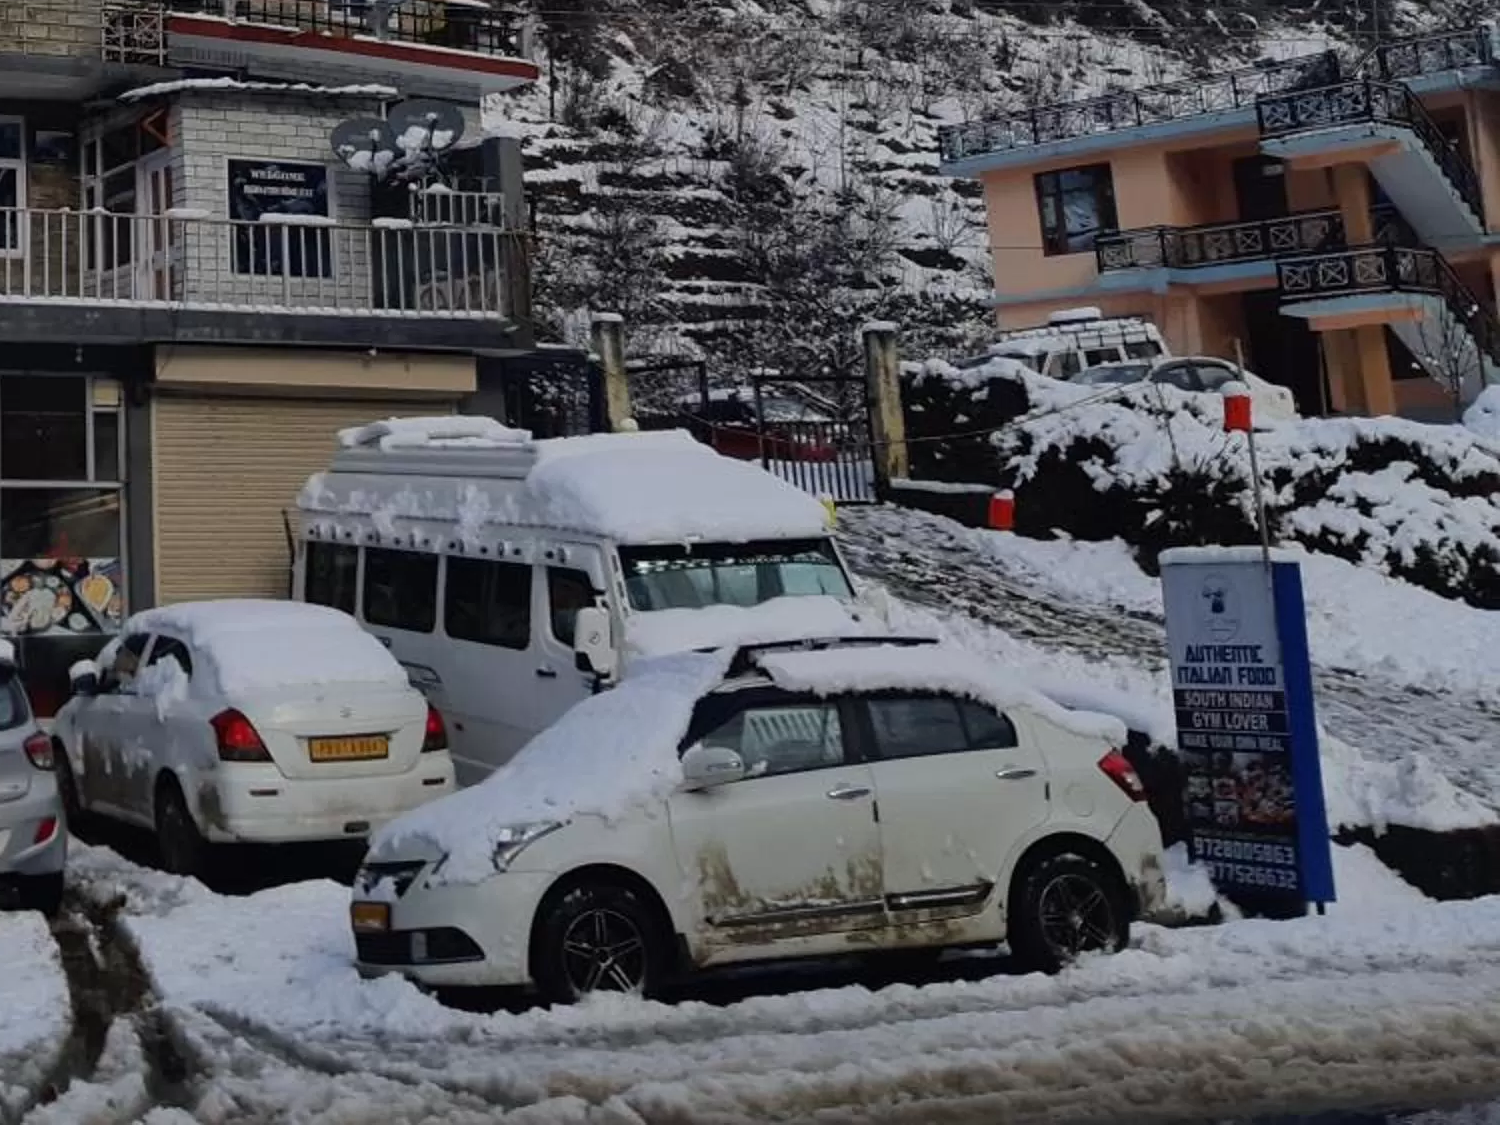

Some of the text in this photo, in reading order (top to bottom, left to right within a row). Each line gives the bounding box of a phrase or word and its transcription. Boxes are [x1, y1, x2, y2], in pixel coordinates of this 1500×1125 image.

[1185, 644, 1264, 663] AUTHENTIC
[1177, 666, 1277, 686] ITALIAN FOOD
[1184, 691, 1274, 709] SOUTH INDIAN
[1192, 712, 1269, 731] GYM LOVER
